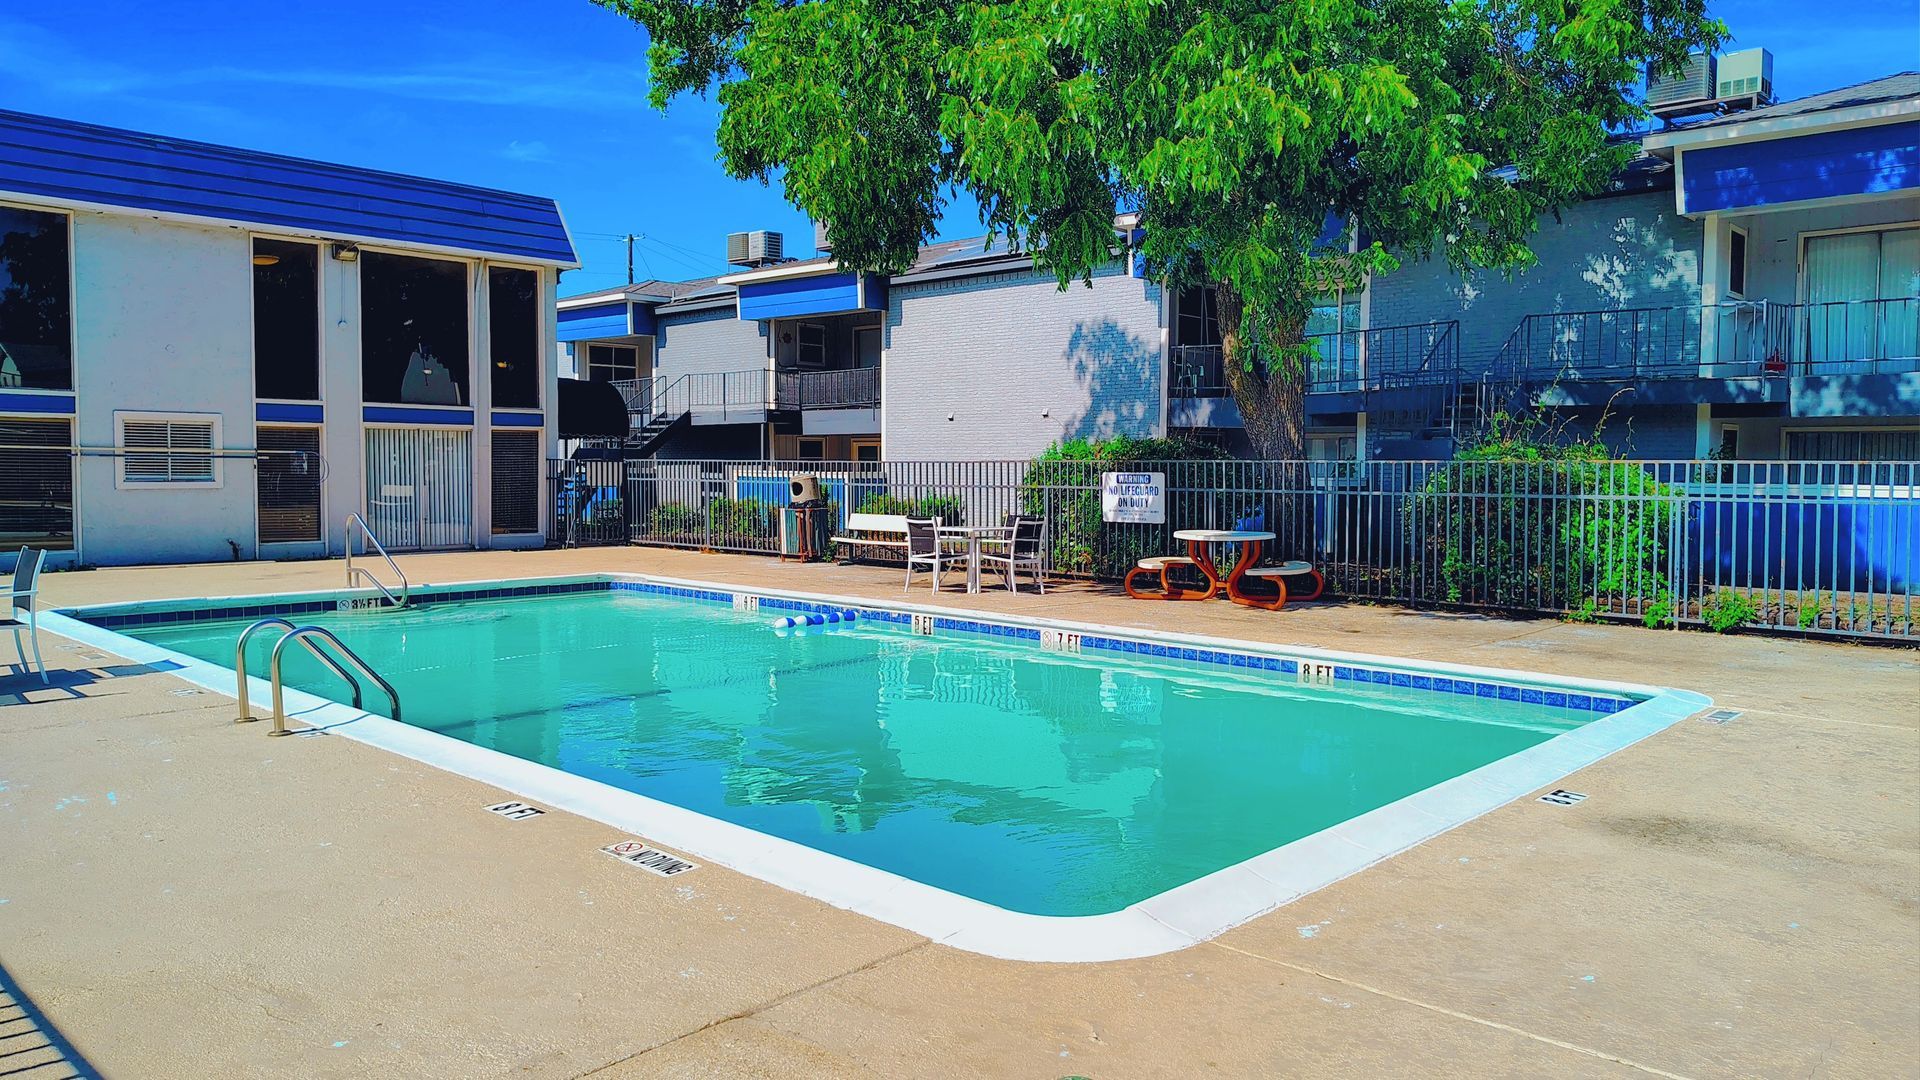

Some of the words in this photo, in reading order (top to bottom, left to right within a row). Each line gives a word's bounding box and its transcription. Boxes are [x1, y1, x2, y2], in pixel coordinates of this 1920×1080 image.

[1118, 475, 1149, 484] WARNING
[1109, 486, 1118, 495] NO
[1120, 486, 1159, 496] LIFEGUARD
[1118, 498, 1128, 507] ON
[1130, 498, 1149, 507] DUTY
[1550, 789, 1588, 801] FT
[503, 807, 546, 820] FT
[639, 855, 693, 875] DIVING
